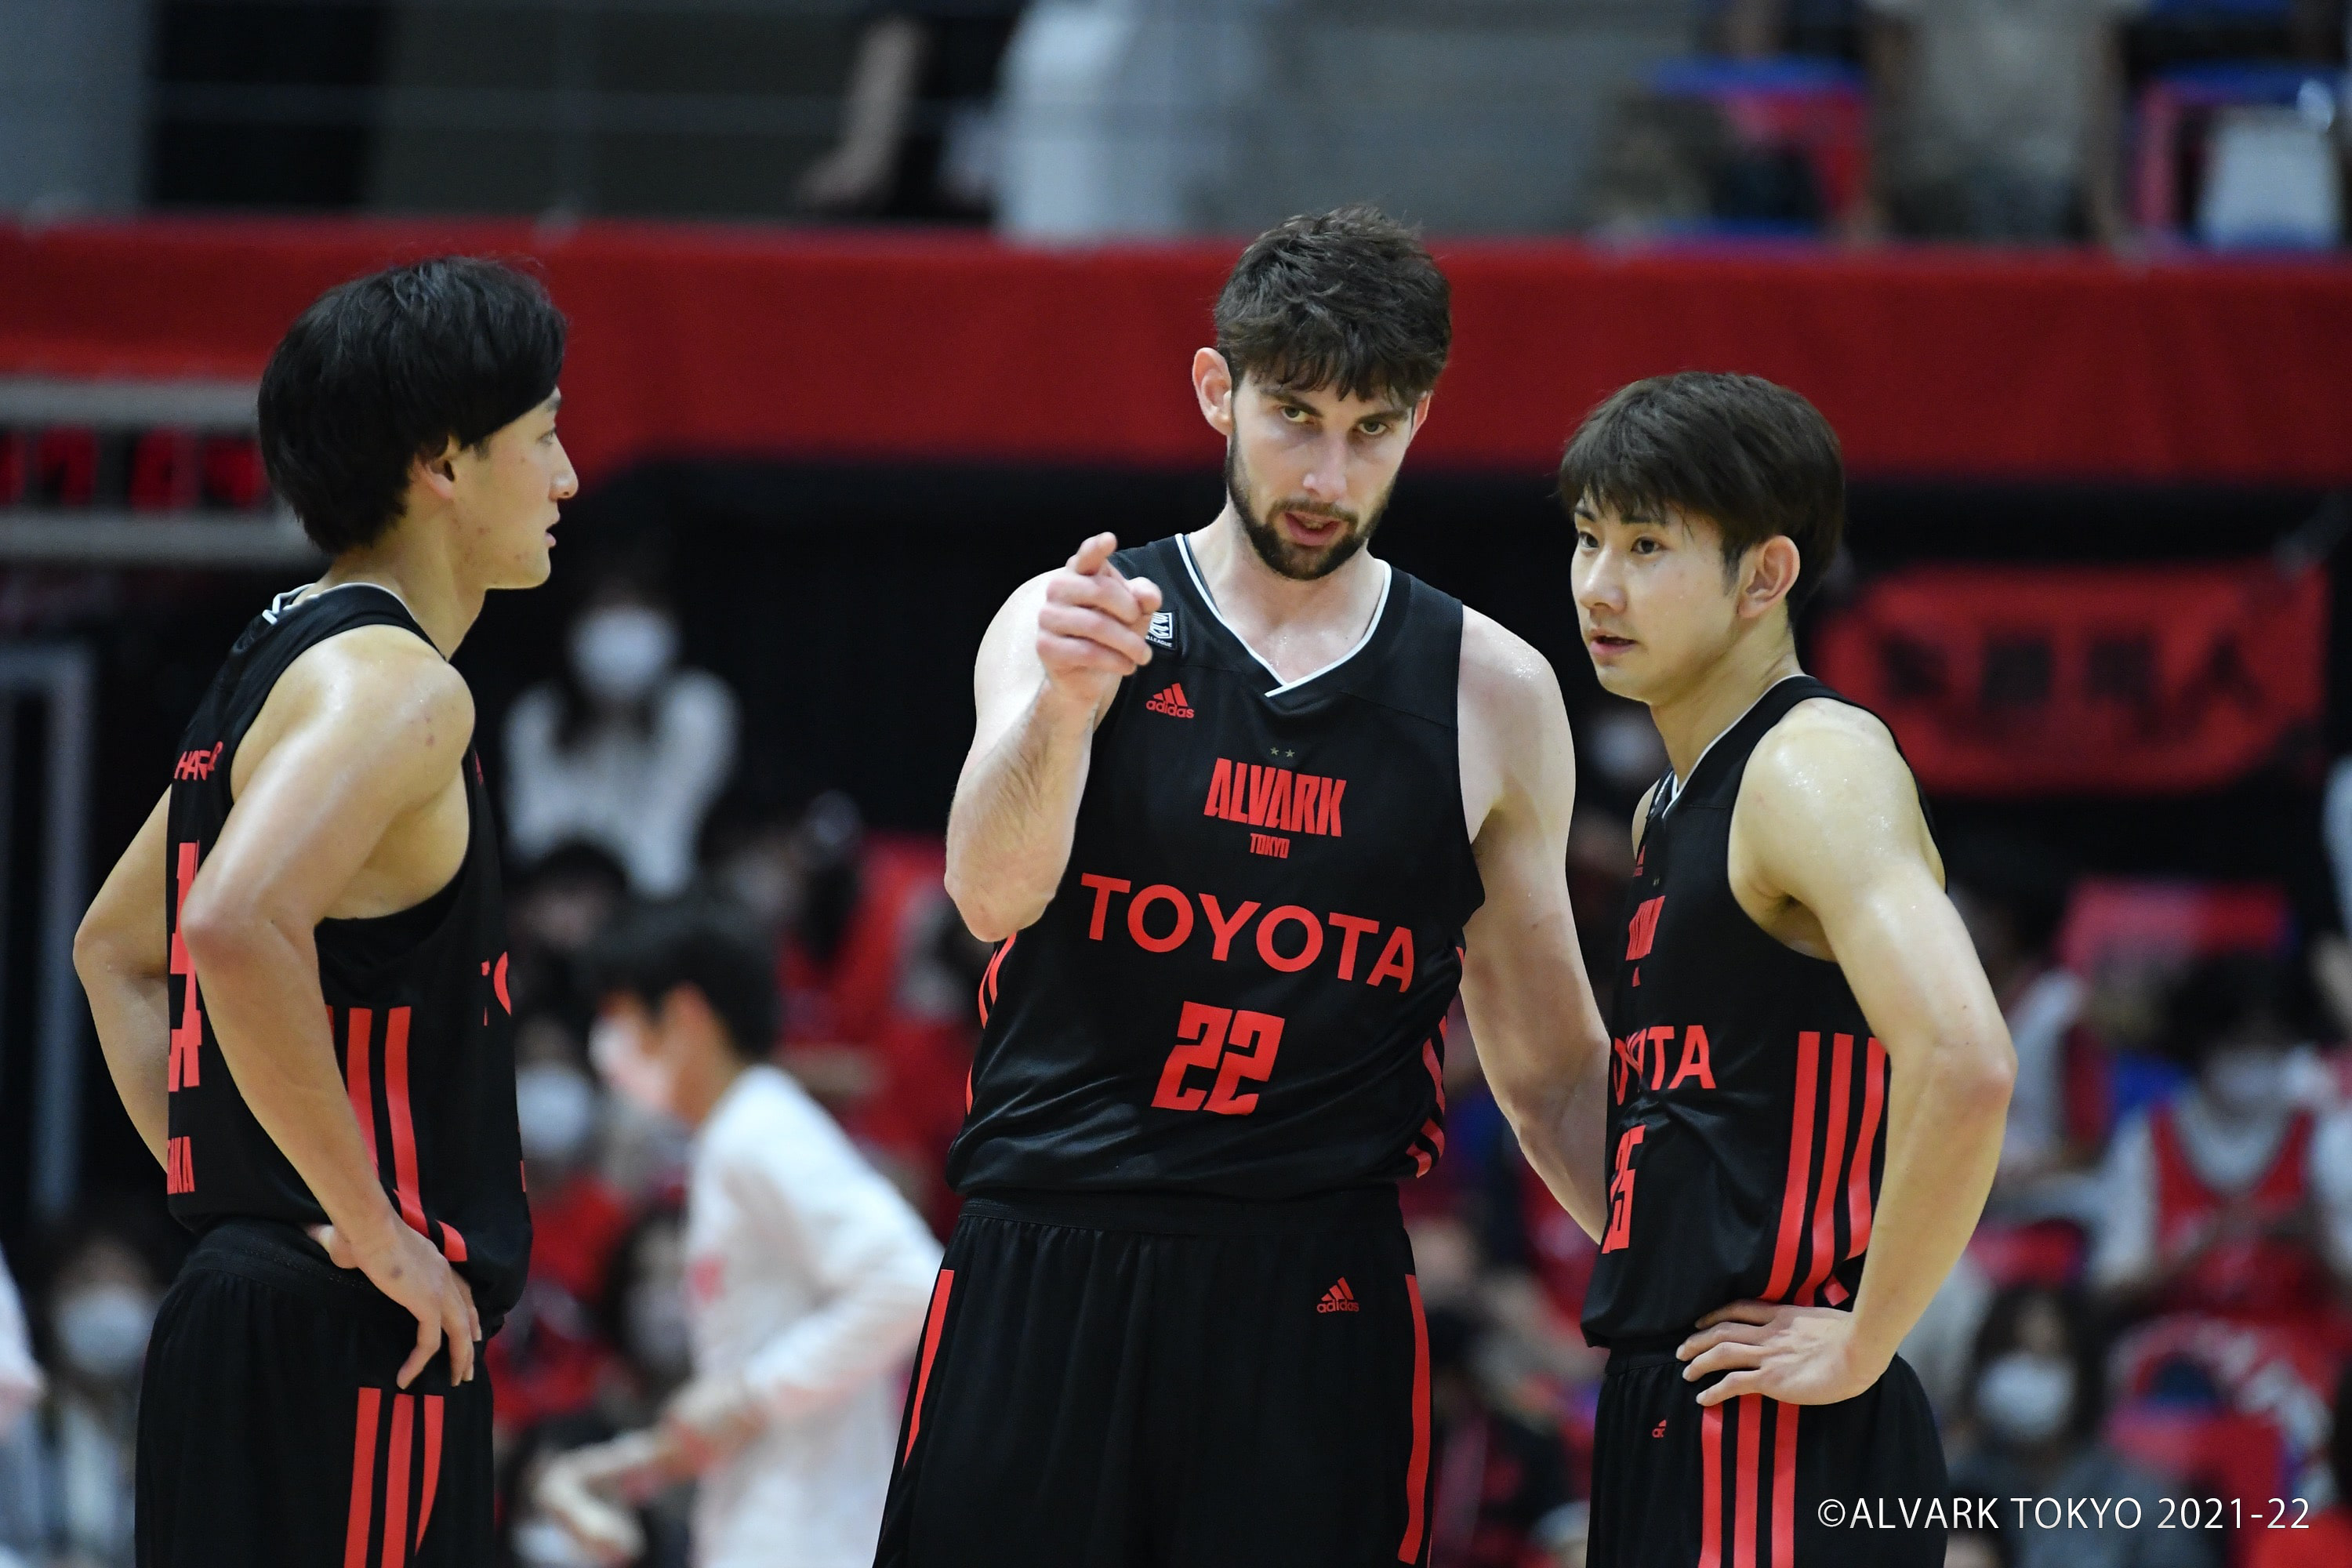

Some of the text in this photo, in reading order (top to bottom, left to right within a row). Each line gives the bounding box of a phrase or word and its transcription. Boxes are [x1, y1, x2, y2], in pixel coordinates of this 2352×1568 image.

[1145, 700, 1194, 719] adidas
[1203, 757, 1347, 838] ALVARK
[1250, 833, 1290, 859] TOKYO
[1080, 873, 1414, 993] TOYOTA
[1151, 1001, 1285, 1115] 22
[1316, 1298, 1359, 1313] adidas
